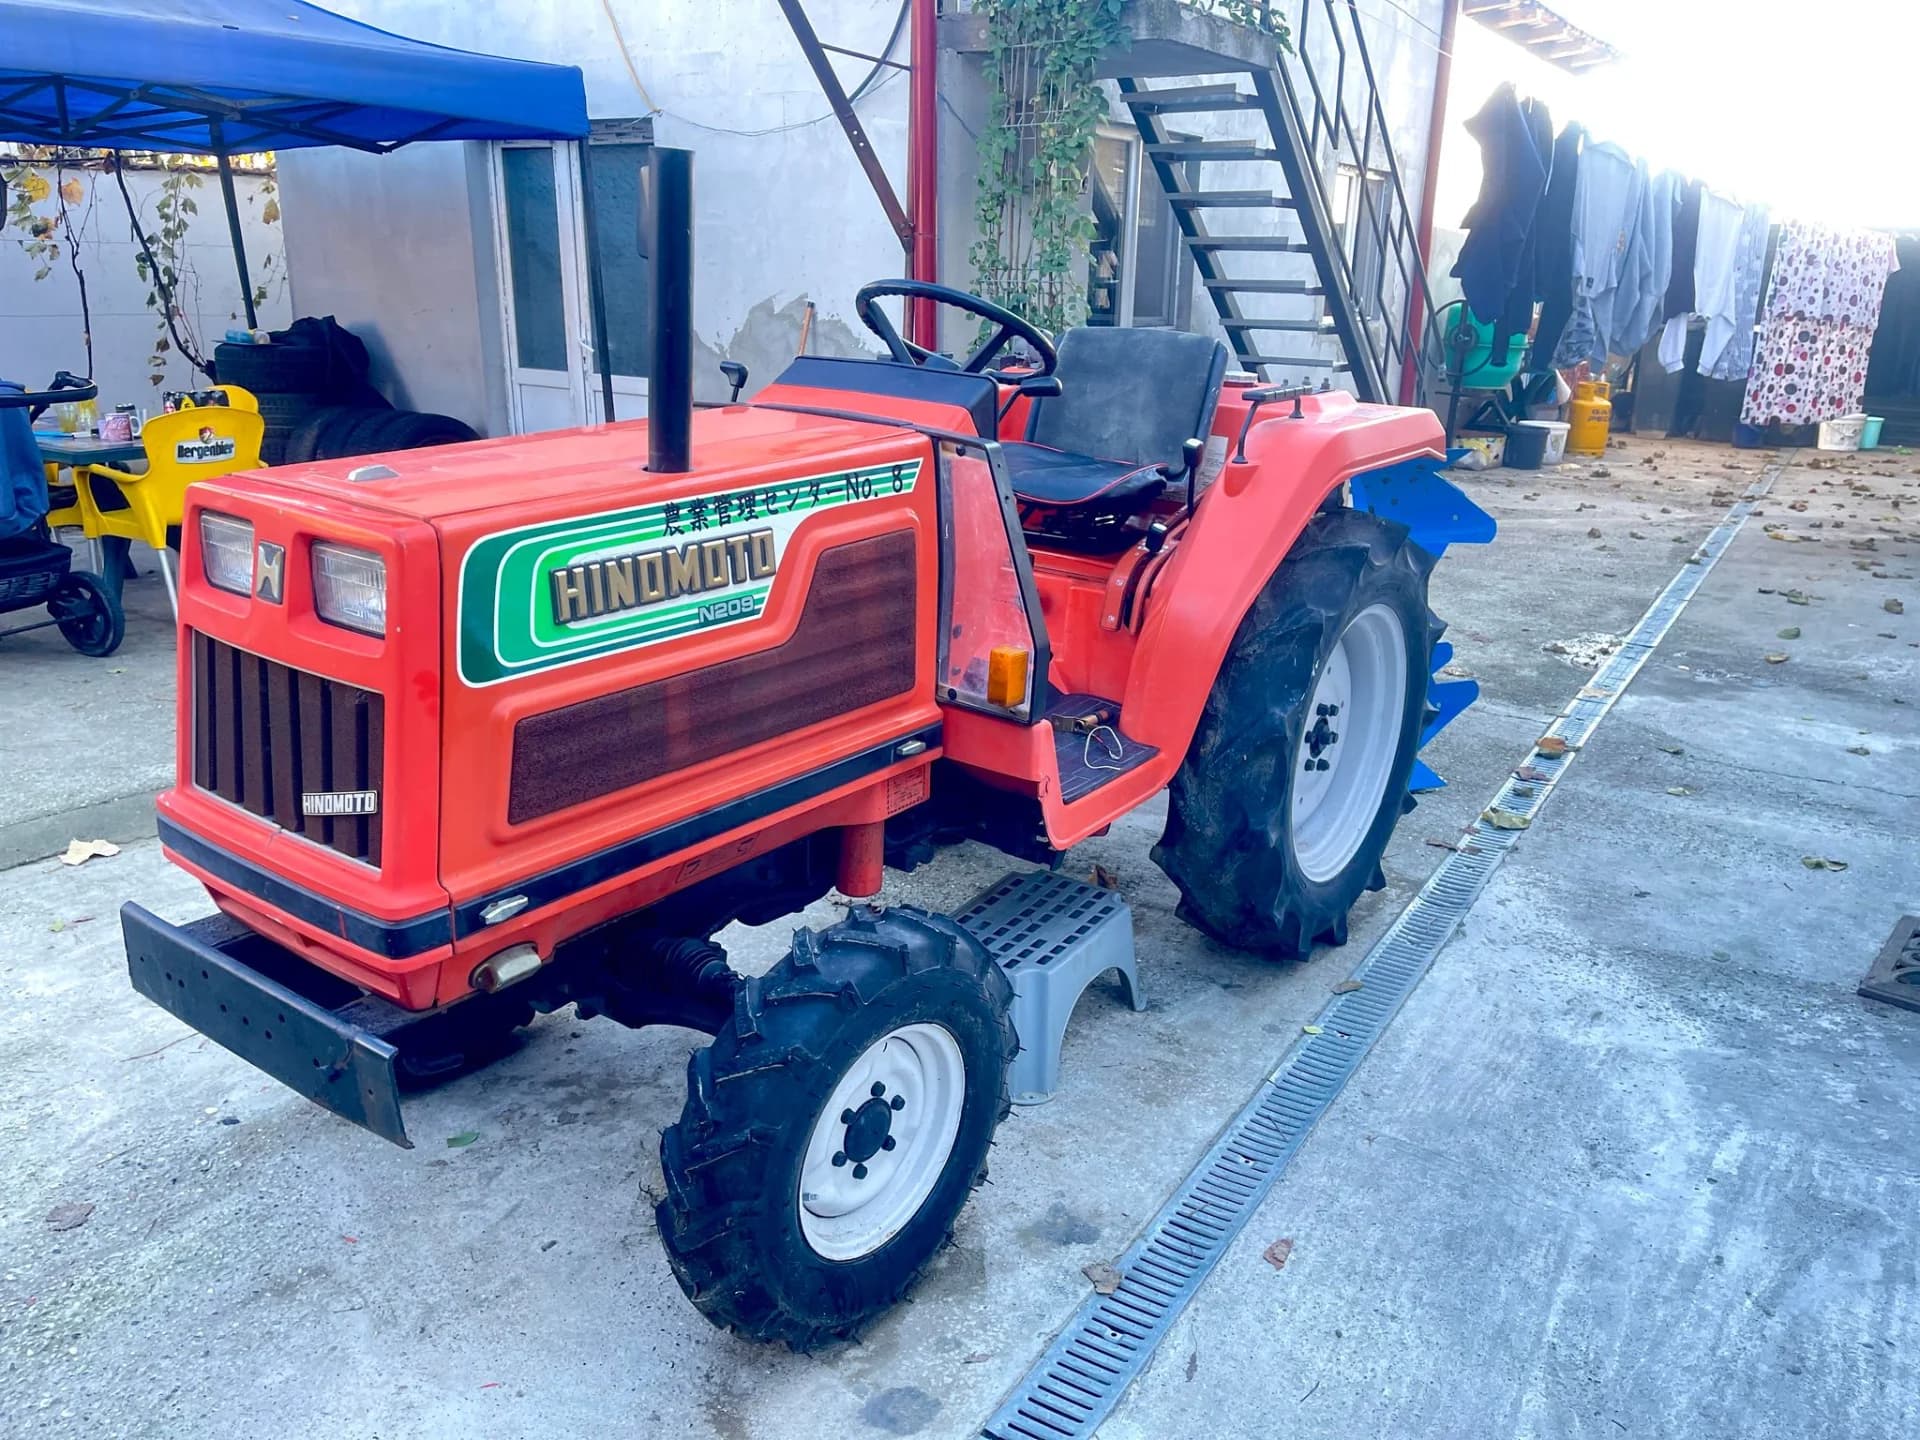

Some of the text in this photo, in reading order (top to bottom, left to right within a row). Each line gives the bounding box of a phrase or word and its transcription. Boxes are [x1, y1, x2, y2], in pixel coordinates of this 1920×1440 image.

[177, 441, 234, 460] Bergenbier
[892, 465, 903, 493] 8
[553, 529, 776, 623] HINOMOTO
[699, 596, 754, 623] N209
[302, 793, 376, 814] HINOMOTO
